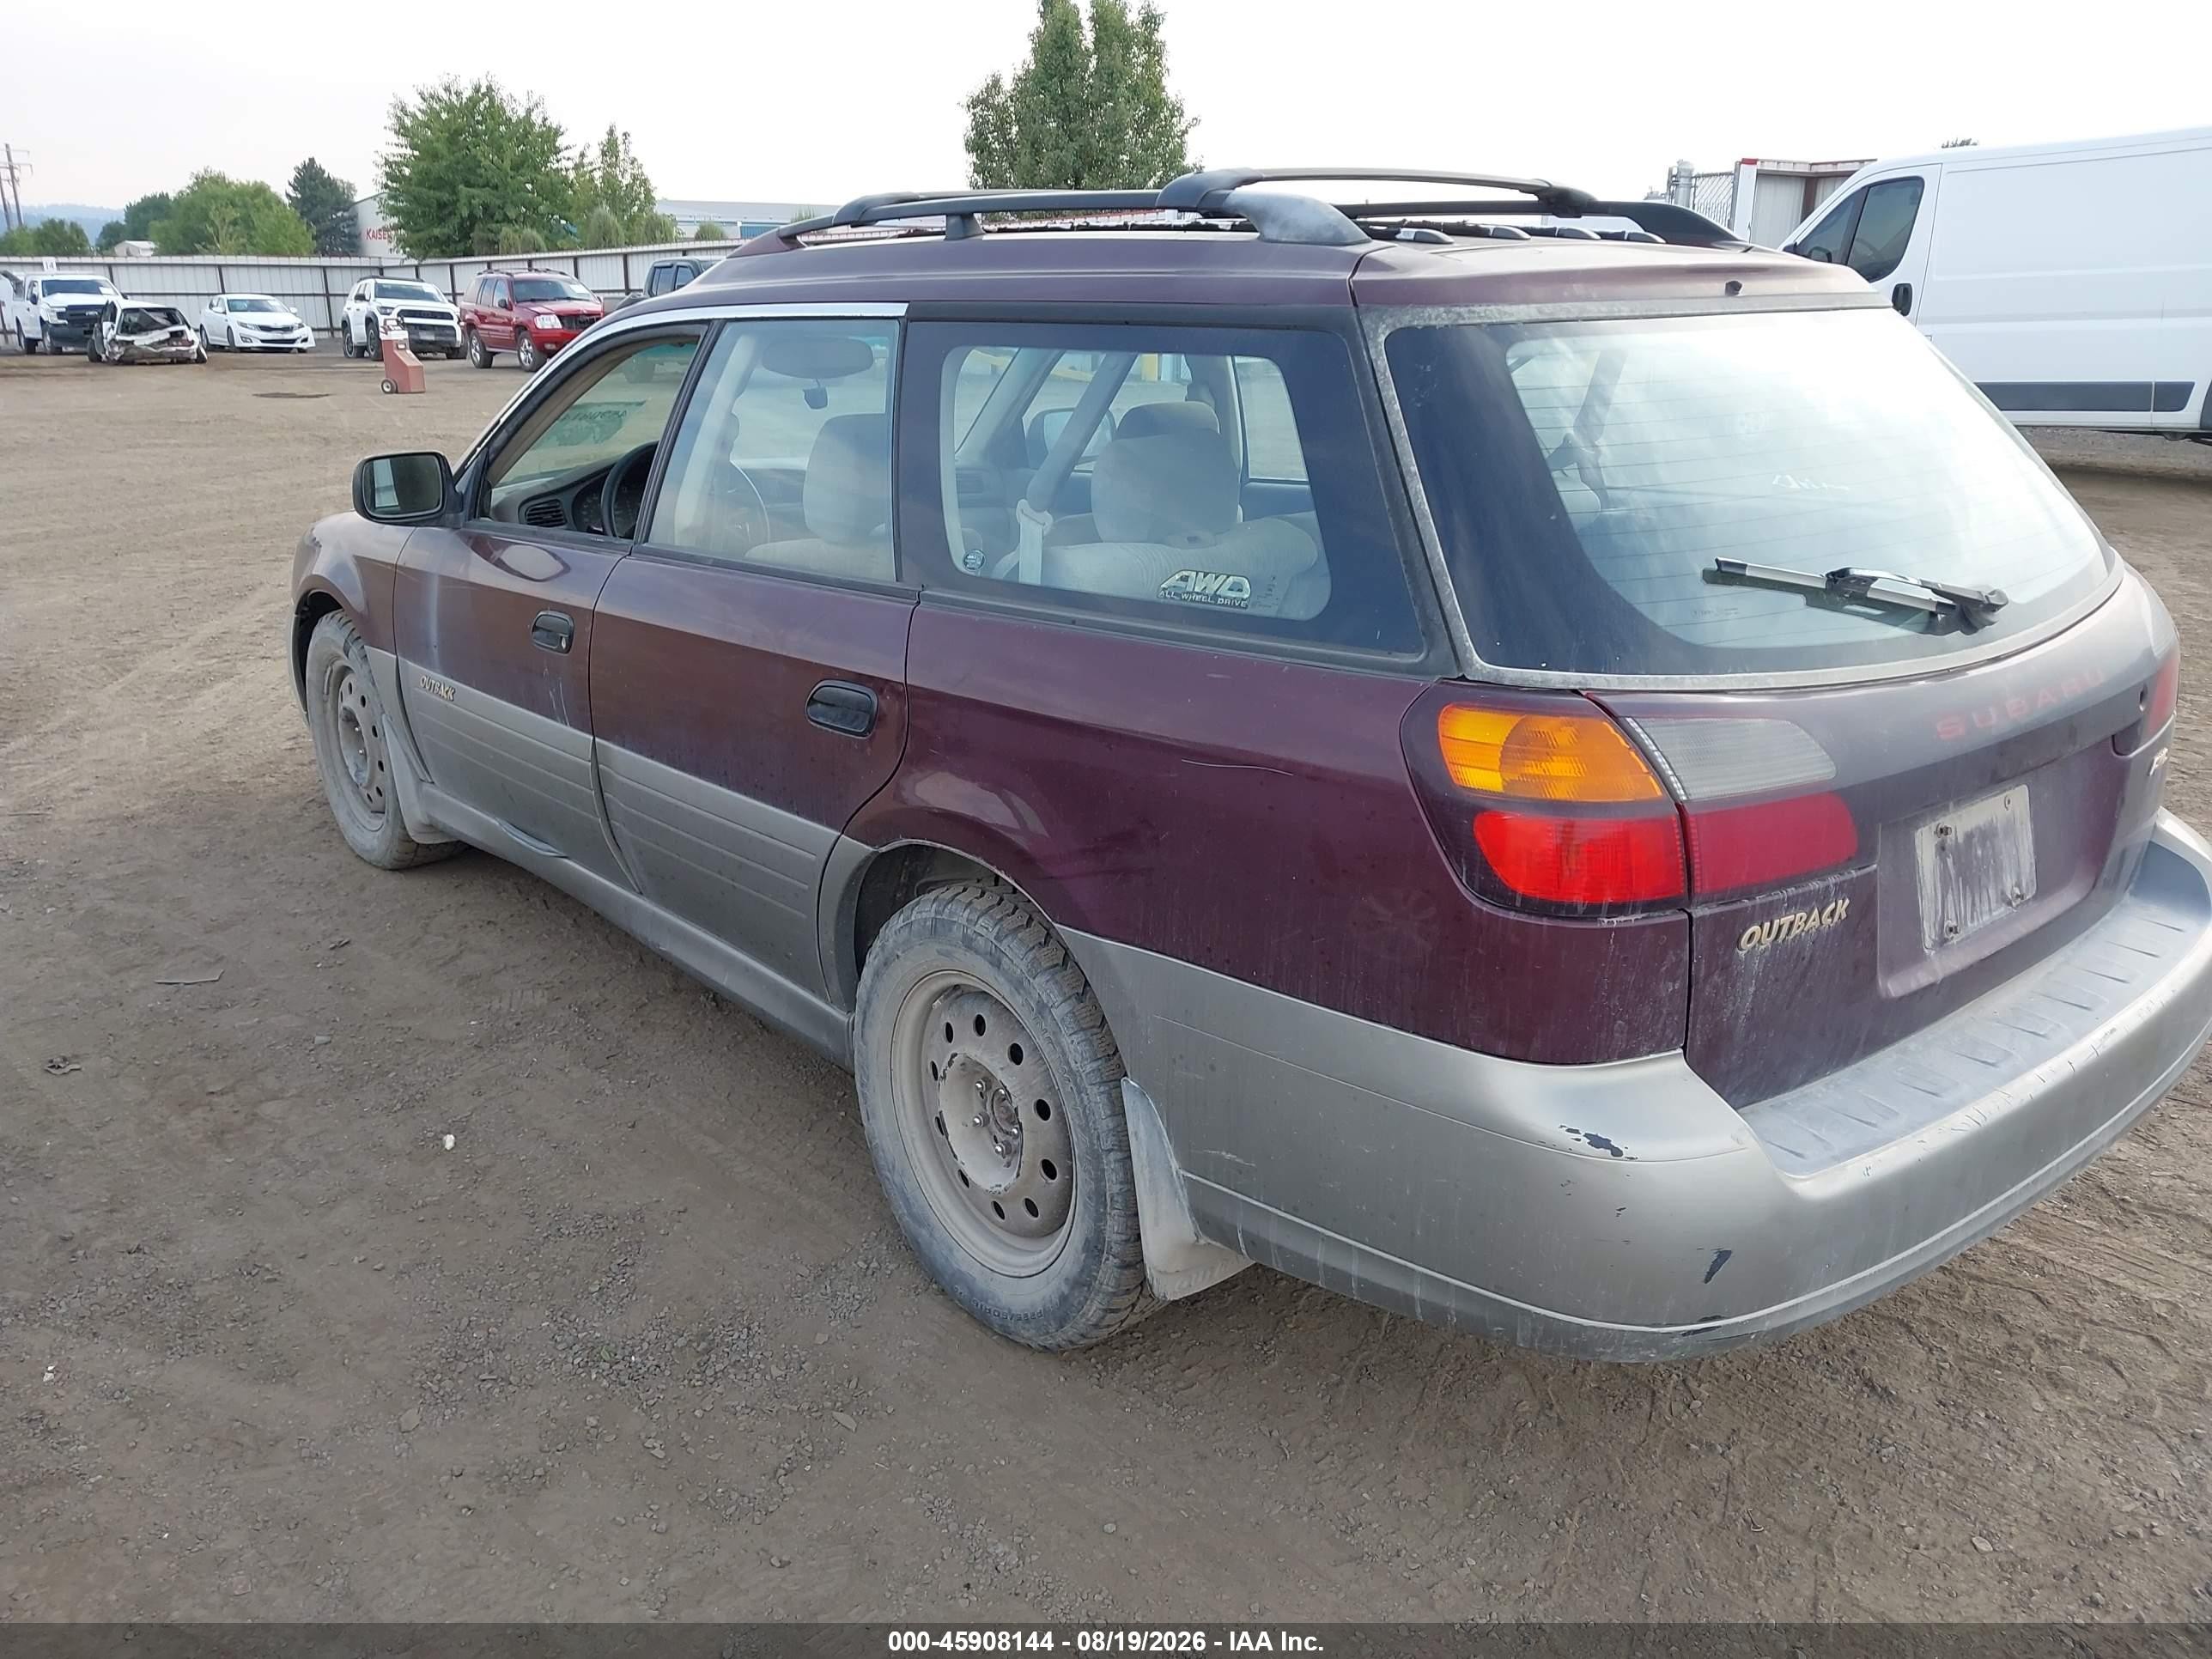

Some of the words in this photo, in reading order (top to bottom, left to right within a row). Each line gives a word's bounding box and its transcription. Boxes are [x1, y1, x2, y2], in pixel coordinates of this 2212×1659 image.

[1158, 590, 1176, 599] ALL
[1181, 592, 1212, 603] WHEEL
[1217, 597, 1249, 608] DRIVE
[1160, 569, 1251, 599] AWD
[420, 675, 455, 701] OUTBACK
[1936, 669, 2104, 741] SUBARU
[1738, 897, 1850, 951] OUTBACK
